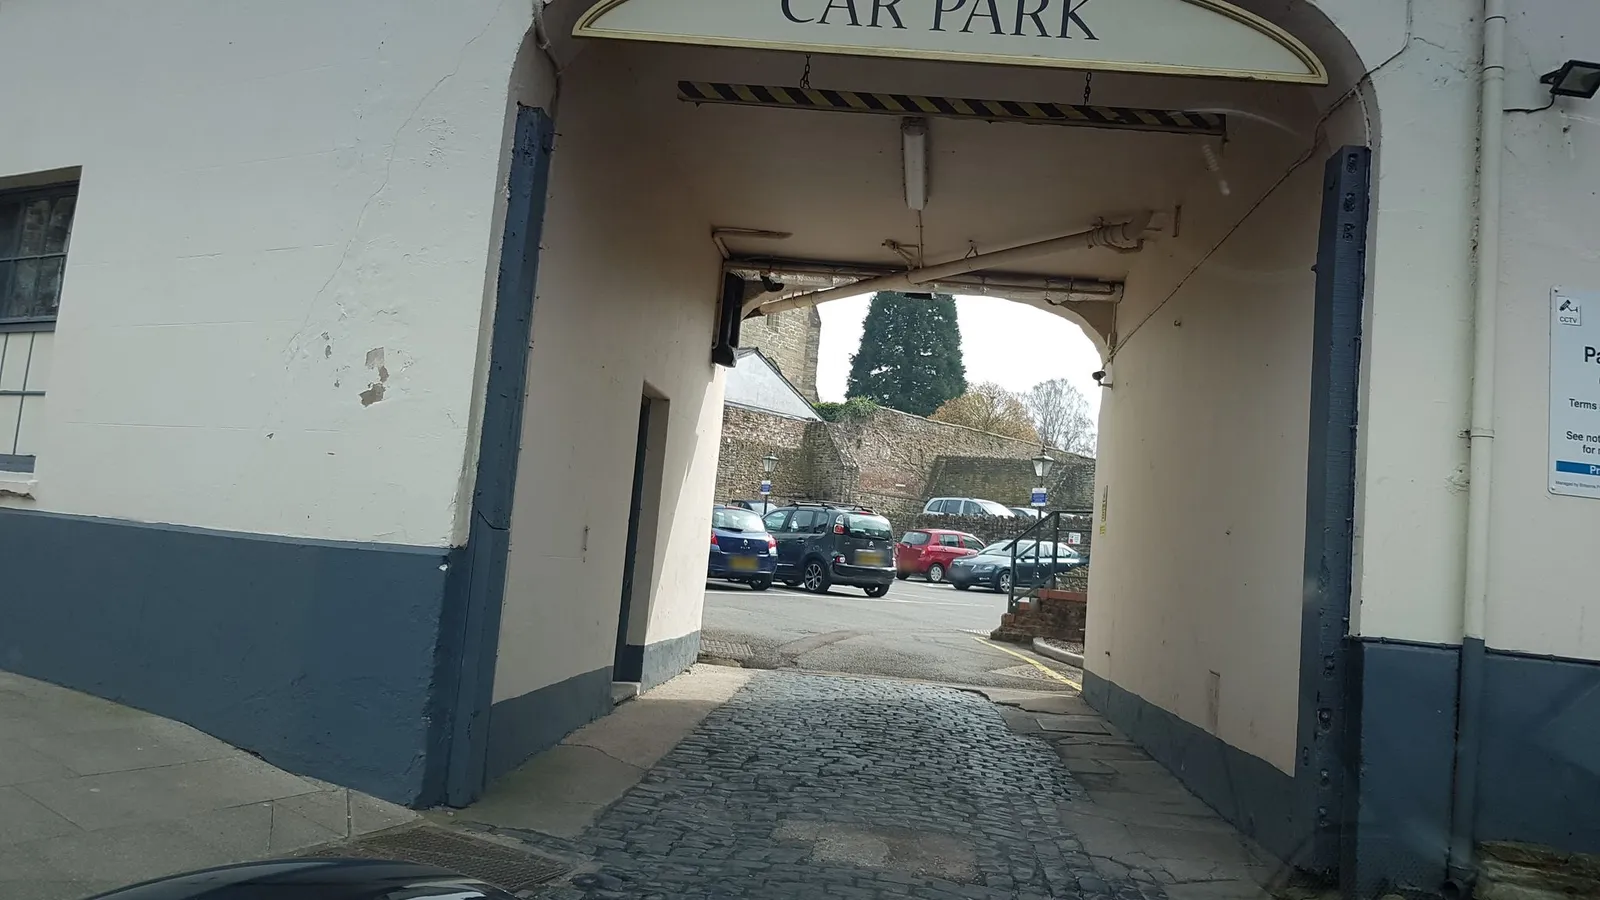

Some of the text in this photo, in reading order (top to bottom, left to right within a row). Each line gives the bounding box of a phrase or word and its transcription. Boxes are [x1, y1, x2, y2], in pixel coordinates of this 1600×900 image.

[781, 0, 1100, 40] CAR PARK
[1569, 398, 1597, 410] Terms
[1566, 430, 1583, 441] See
[1582, 444, 1596, 454] for
